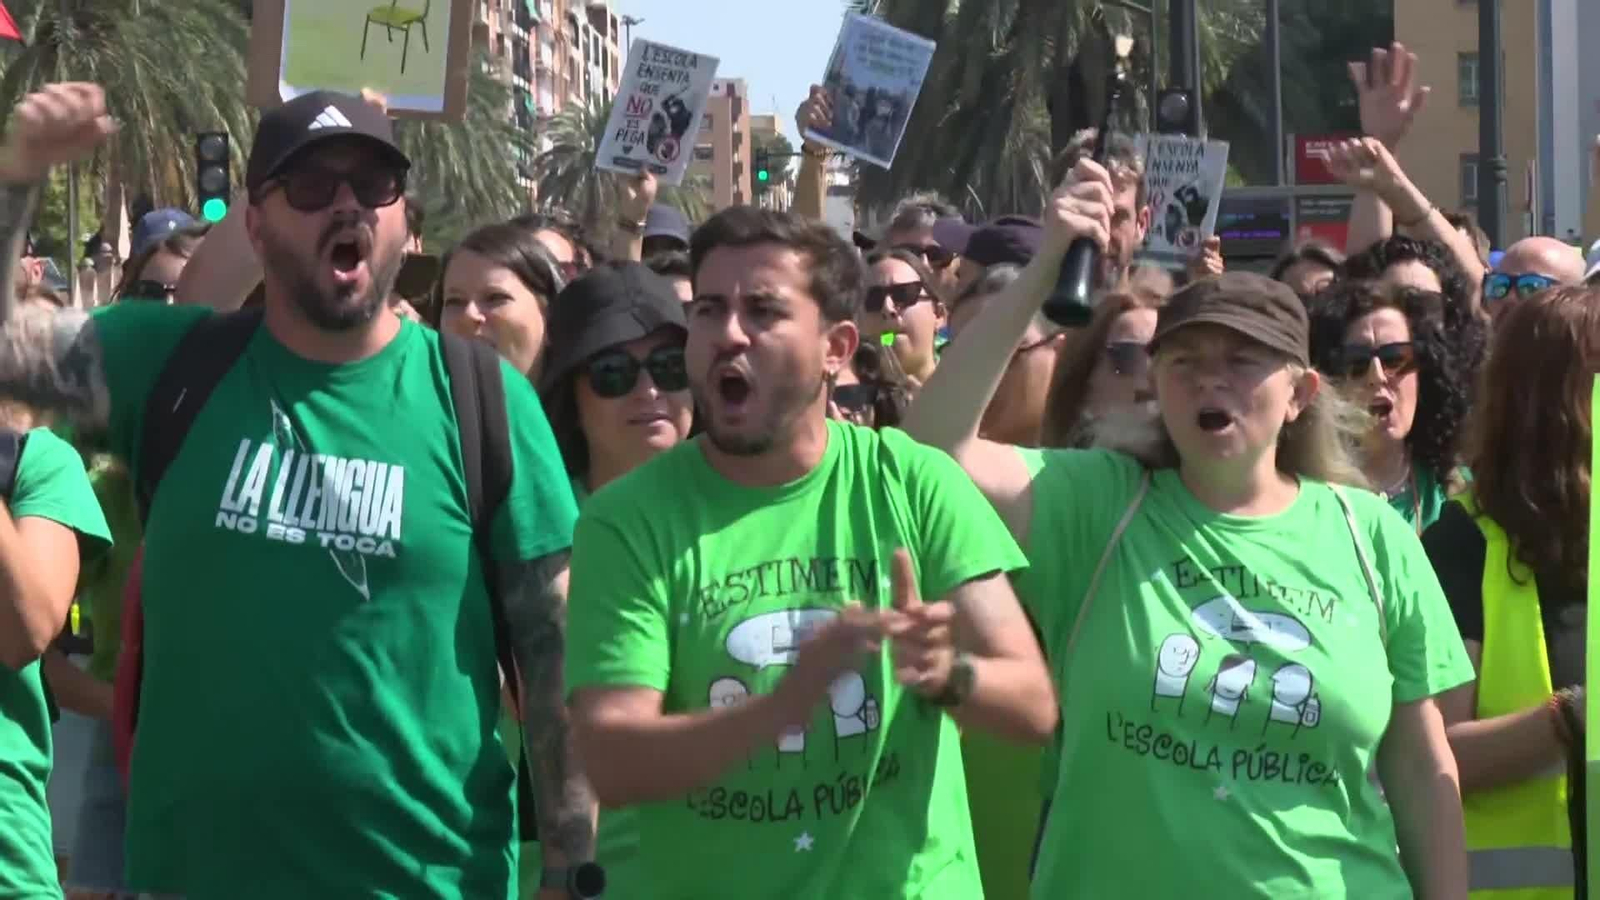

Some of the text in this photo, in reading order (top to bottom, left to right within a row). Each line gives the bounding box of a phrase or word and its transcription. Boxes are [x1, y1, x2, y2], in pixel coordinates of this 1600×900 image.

[626, 95, 654, 116] NO
[614, 128, 646, 146] PEGA
[219, 437, 405, 541] LA LLENGUA
[214, 510, 397, 559] NO ES TOCA
[701, 556, 881, 620] ESTIMEM
[1106, 710, 1341, 788] L'ESCOLA PÚBLICA
